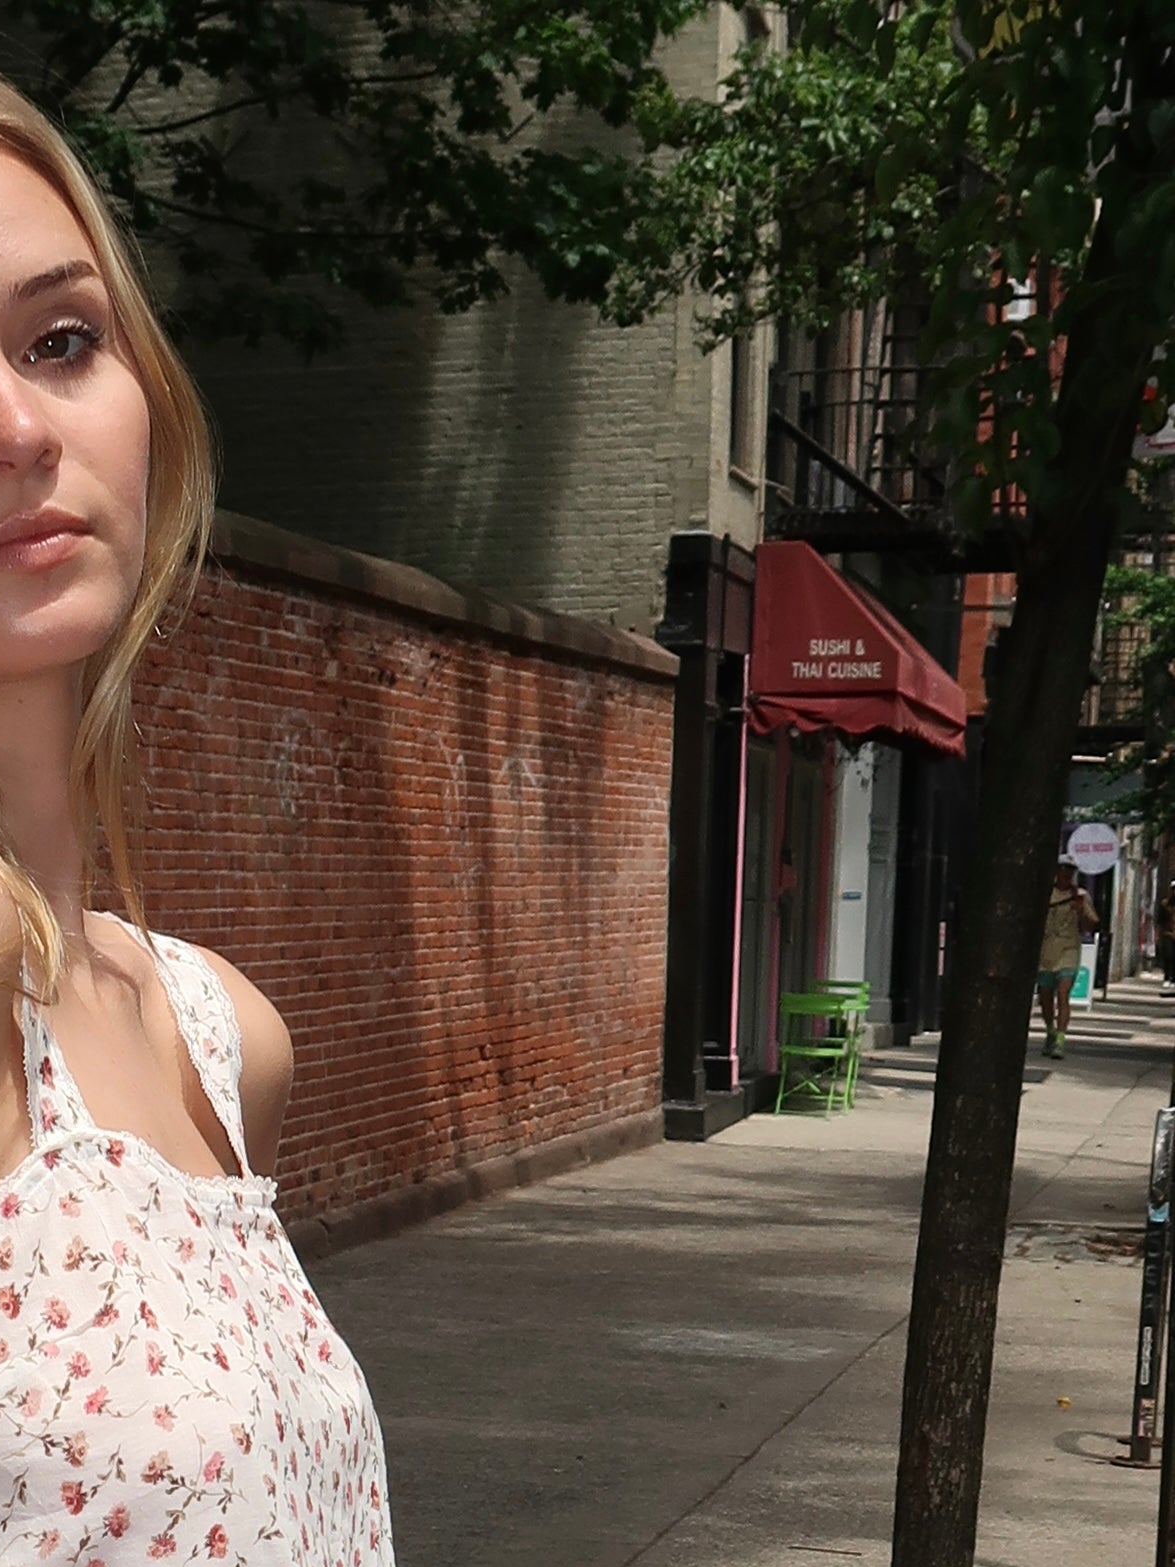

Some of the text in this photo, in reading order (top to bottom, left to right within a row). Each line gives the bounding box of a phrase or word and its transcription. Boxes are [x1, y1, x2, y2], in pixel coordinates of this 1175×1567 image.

[809, 638, 865, 656] SUSHI &
[792, 661, 882, 678] THAI CUISINE
